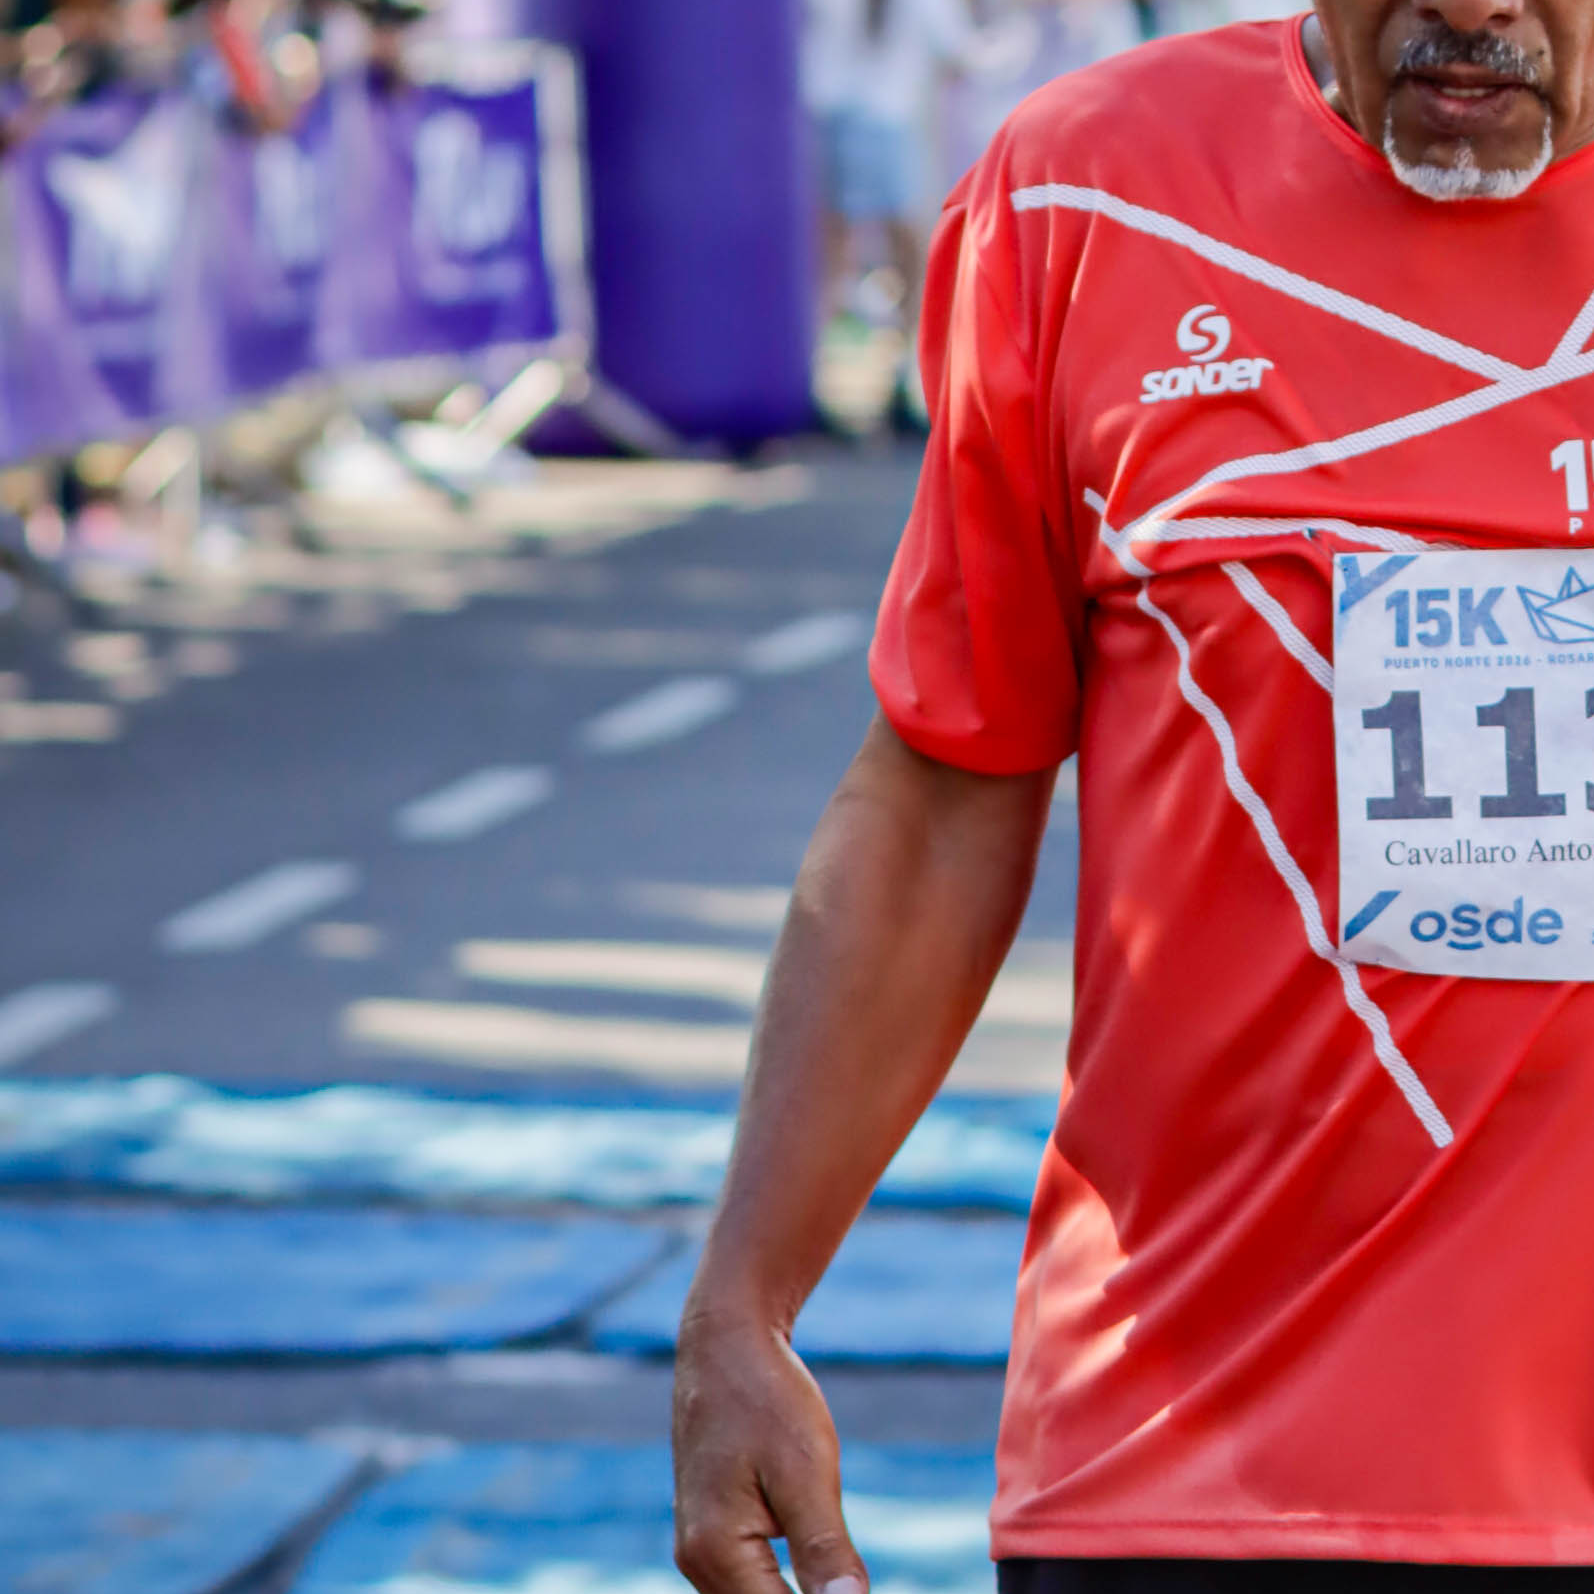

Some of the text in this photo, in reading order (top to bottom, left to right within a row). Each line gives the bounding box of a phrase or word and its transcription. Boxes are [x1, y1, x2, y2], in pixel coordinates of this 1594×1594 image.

[1384, 586, 1508, 648] 15K
[1384, 655, 1441, 670] PUERTO
[1444, 654, 1491, 668] NORTE
[1385, 839, 1517, 866] Cavallaro
[1409, 896, 1564, 946] osde
